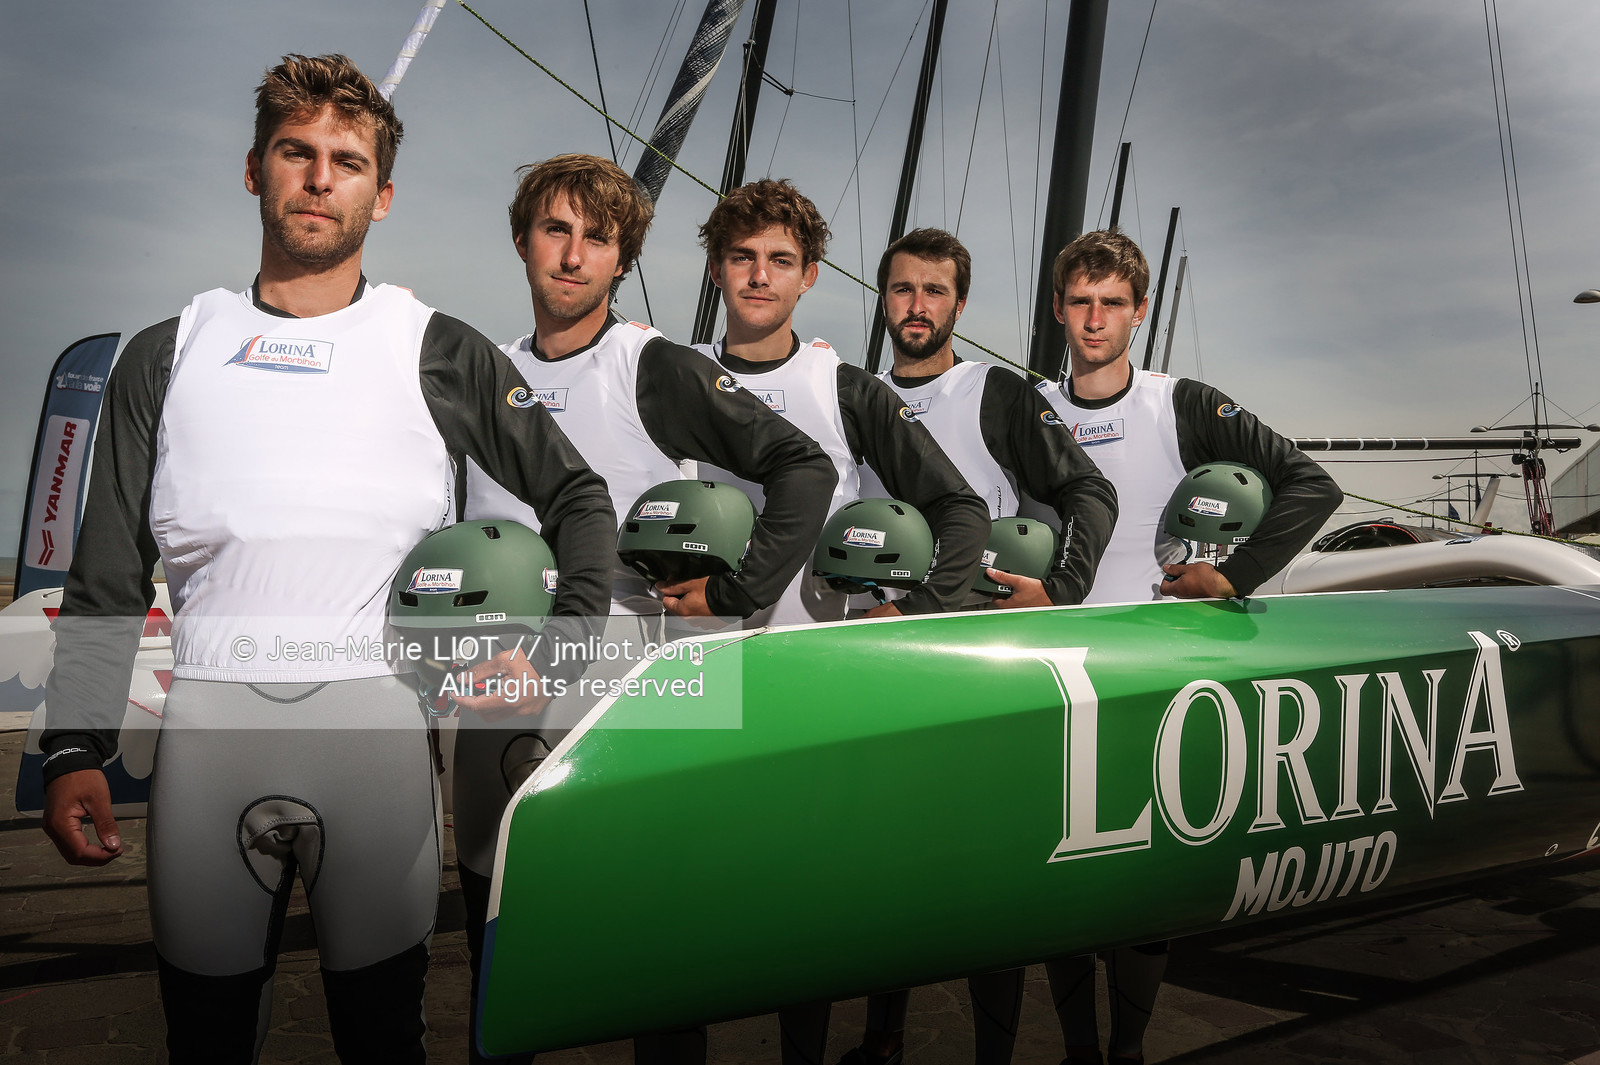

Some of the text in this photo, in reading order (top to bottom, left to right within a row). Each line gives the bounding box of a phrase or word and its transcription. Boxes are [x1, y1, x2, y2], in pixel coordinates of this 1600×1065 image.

[258, 341, 315, 358] LORINA
[248, 353, 270, 362] Golfe
[279, 355, 322, 368] Morbihan
[1079, 423, 1114, 437] LORINA
[44, 421, 77, 523] YANMAR
[421, 572, 452, 582] LORINA
[1035, 630, 1525, 864] LORINA
[1221, 830, 1398, 922] MOJITO
